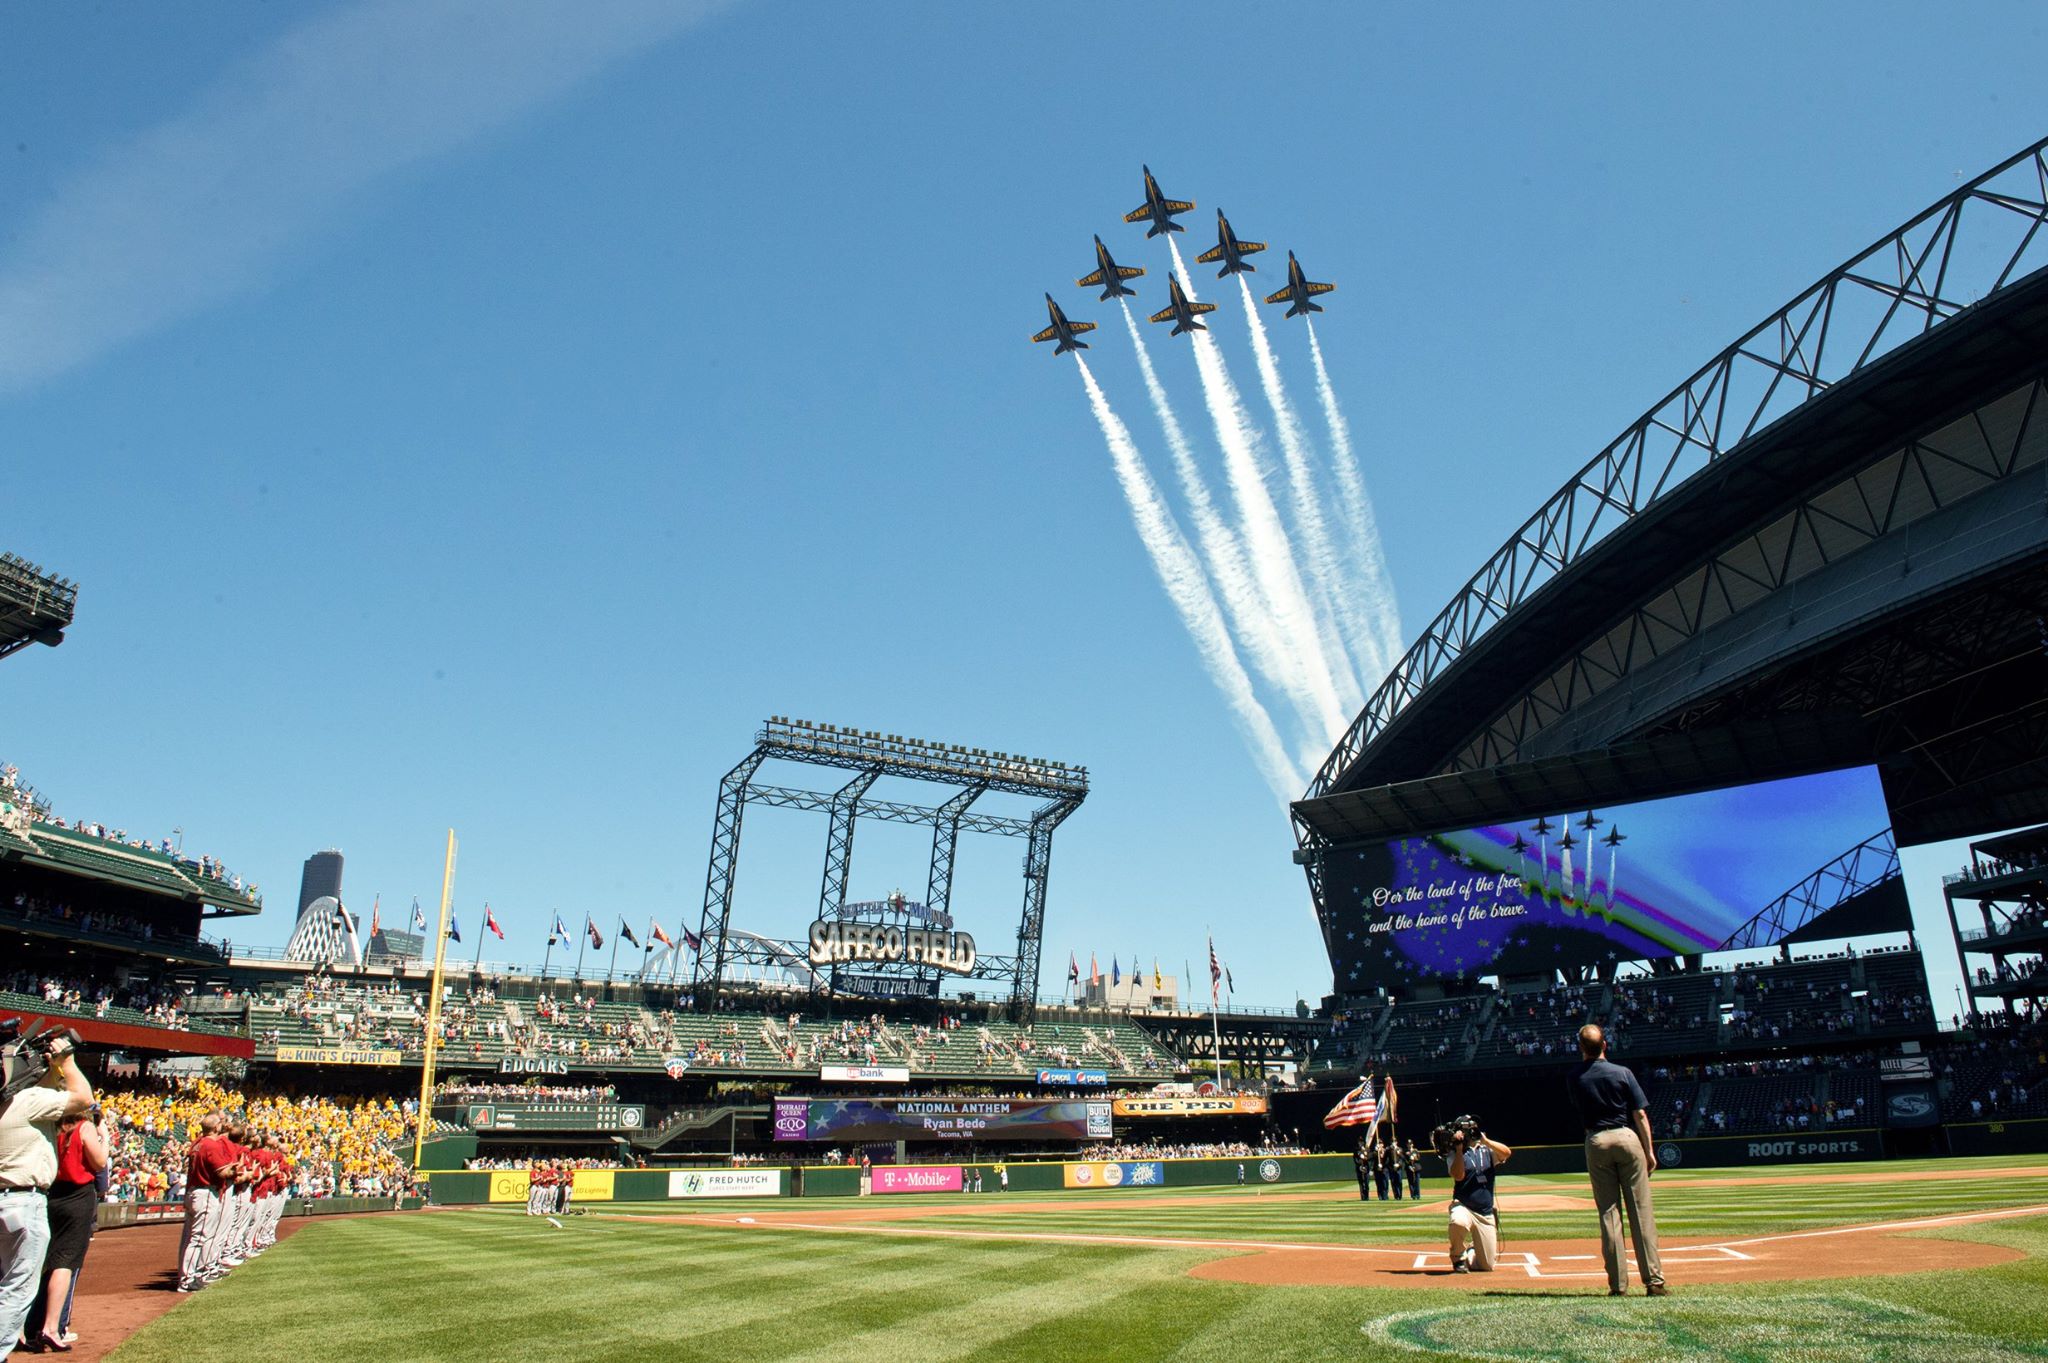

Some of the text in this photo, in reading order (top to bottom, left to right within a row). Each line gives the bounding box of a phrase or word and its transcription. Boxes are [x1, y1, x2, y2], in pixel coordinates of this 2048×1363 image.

[1372, 887, 1402, 906] O'er
[1406, 886, 1424, 900] the
[1428, 880, 1456, 898] land
[1459, 878, 1473, 900] of
[1476, 877, 1494, 892] the
[910, 902, 954, 929] MARINERS
[1368, 902, 1528, 933] and the home of the brave.
[809, 920, 976, 977] SAFECO FIELD
[854, 976, 930, 994] TRUE TO THE BLUE
[296, 1050, 384, 1063] KING'S COURT
[502, 1059, 568, 1074] EDGARS
[668, 1066, 684, 1078] 42
[1052, 1073, 1070, 1082] pepsi
[1087, 1074, 1106, 1082] pepsi
[898, 1104, 1010, 1112] NATIONAL ANTHEM
[1090, 1107, 1109, 1116] BUILT
[1124, 1102, 1173, 1111] THE
[924, 1118, 986, 1130] Ryan Bede
[1748, 1141, 1858, 1157] ROOT SPORTS
[737, 1176, 768, 1184] HUTCH
